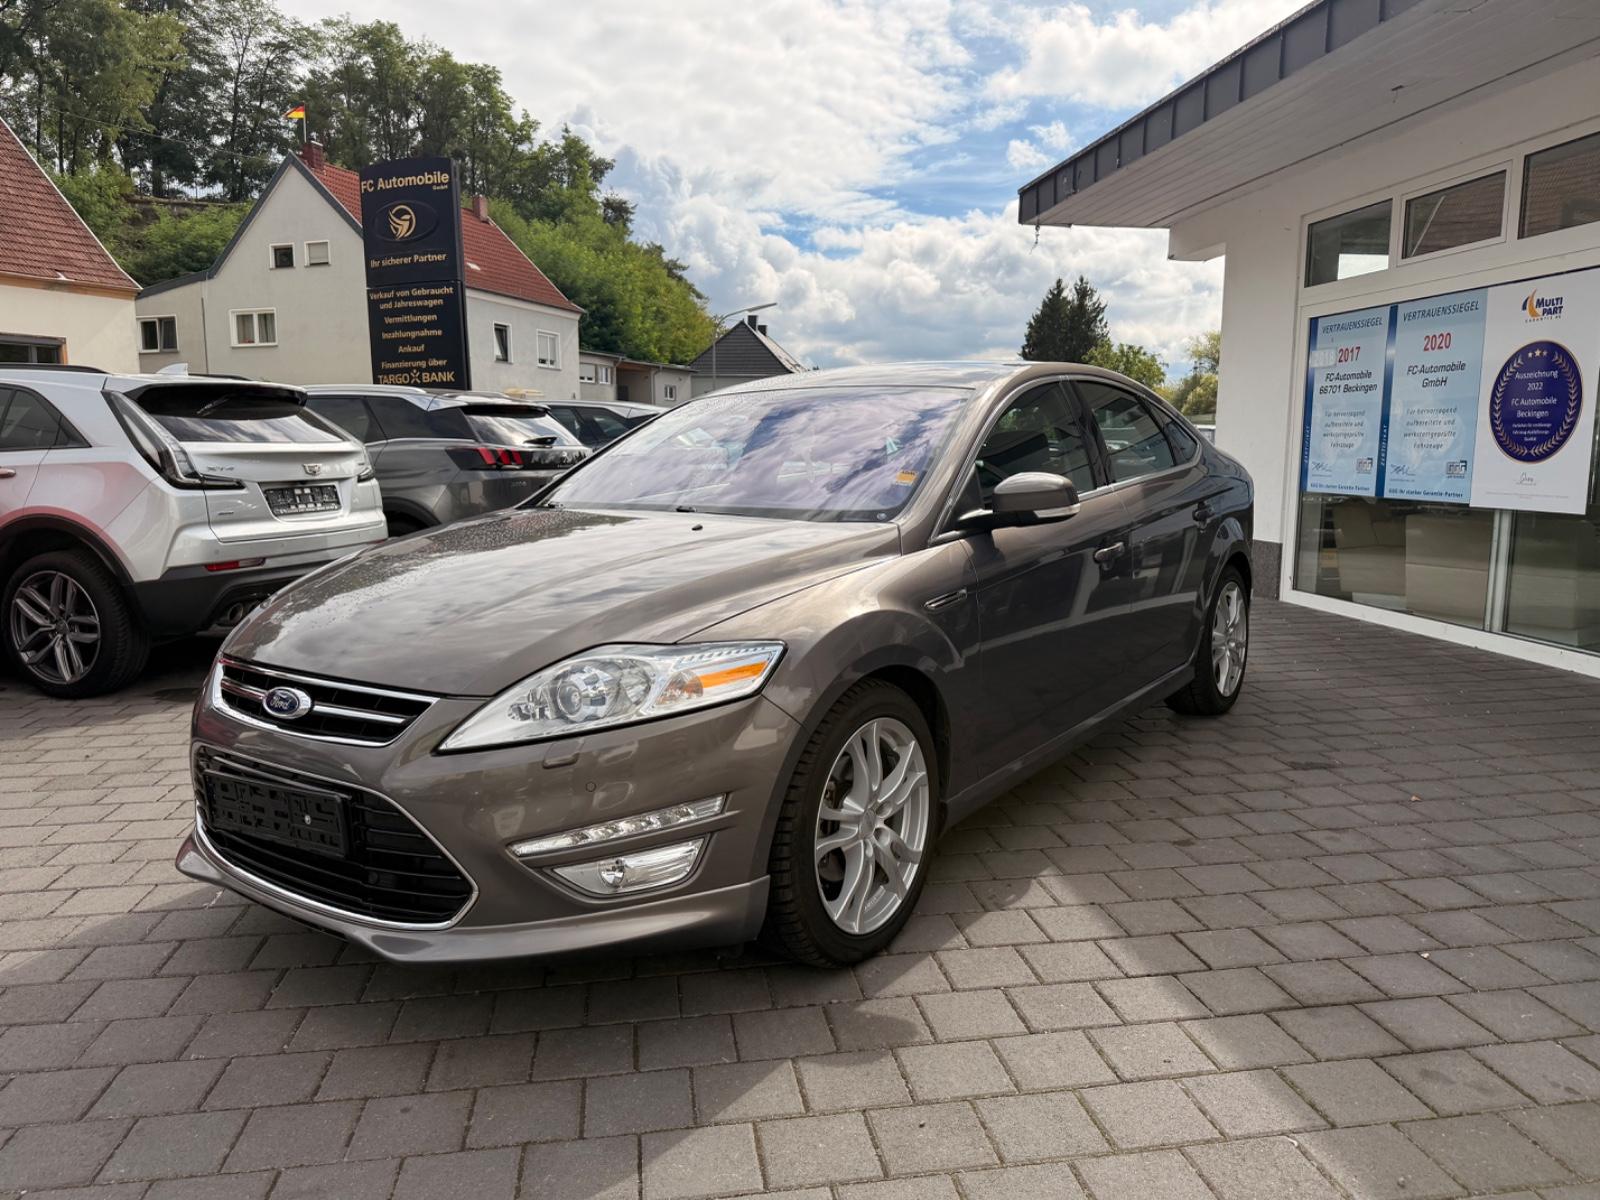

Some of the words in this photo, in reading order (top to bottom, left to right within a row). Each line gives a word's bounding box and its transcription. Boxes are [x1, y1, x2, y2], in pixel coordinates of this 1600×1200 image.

[361, 180, 374, 193] FC
[377, 171, 449, 190] Automobile
[370, 259, 380, 268] Ihr
[382, 256, 412, 266] sicherer
[414, 254, 446, 262] Partner
[370, 290, 394, 300] Verkauf
[412, 286, 454, 296] Gebraucht
[394, 299, 444, 308] Jahreswagen
[1536, 296, 1563, 308] MULTI
[1404, 301, 1480, 322] VERTRAUENSSIEGEL
[1542, 306, 1563, 316] PART
[384, 314, 438, 324] Vermittlungen
[1322, 316, 1383, 334] VERTRAUENSSIEGEL
[382, 329, 442, 339] Inzahlungnahme
[1424, 332, 1452, 352] 2020
[398, 344, 425, 352] Ankauf
[1338, 346, 1360, 363] 2017
[382, 360, 426, 368] Finanzierung
[428, 358, 448, 366] über
[1407, 361, 1466, 375] FC-Automobile
[1515, 370, 1558, 380] Auszeichnung
[1422, 377, 1448, 388] GmbH
[1527, 382, 1544, 391] 2022
[1320, 384, 1340, 395] 66701
[1343, 382, 1378, 394] Beckingen
[1520, 396, 1557, 406] Automobile
[1516, 410, 1549, 418] Beckingen
[270, 696, 292, 710] Ford
